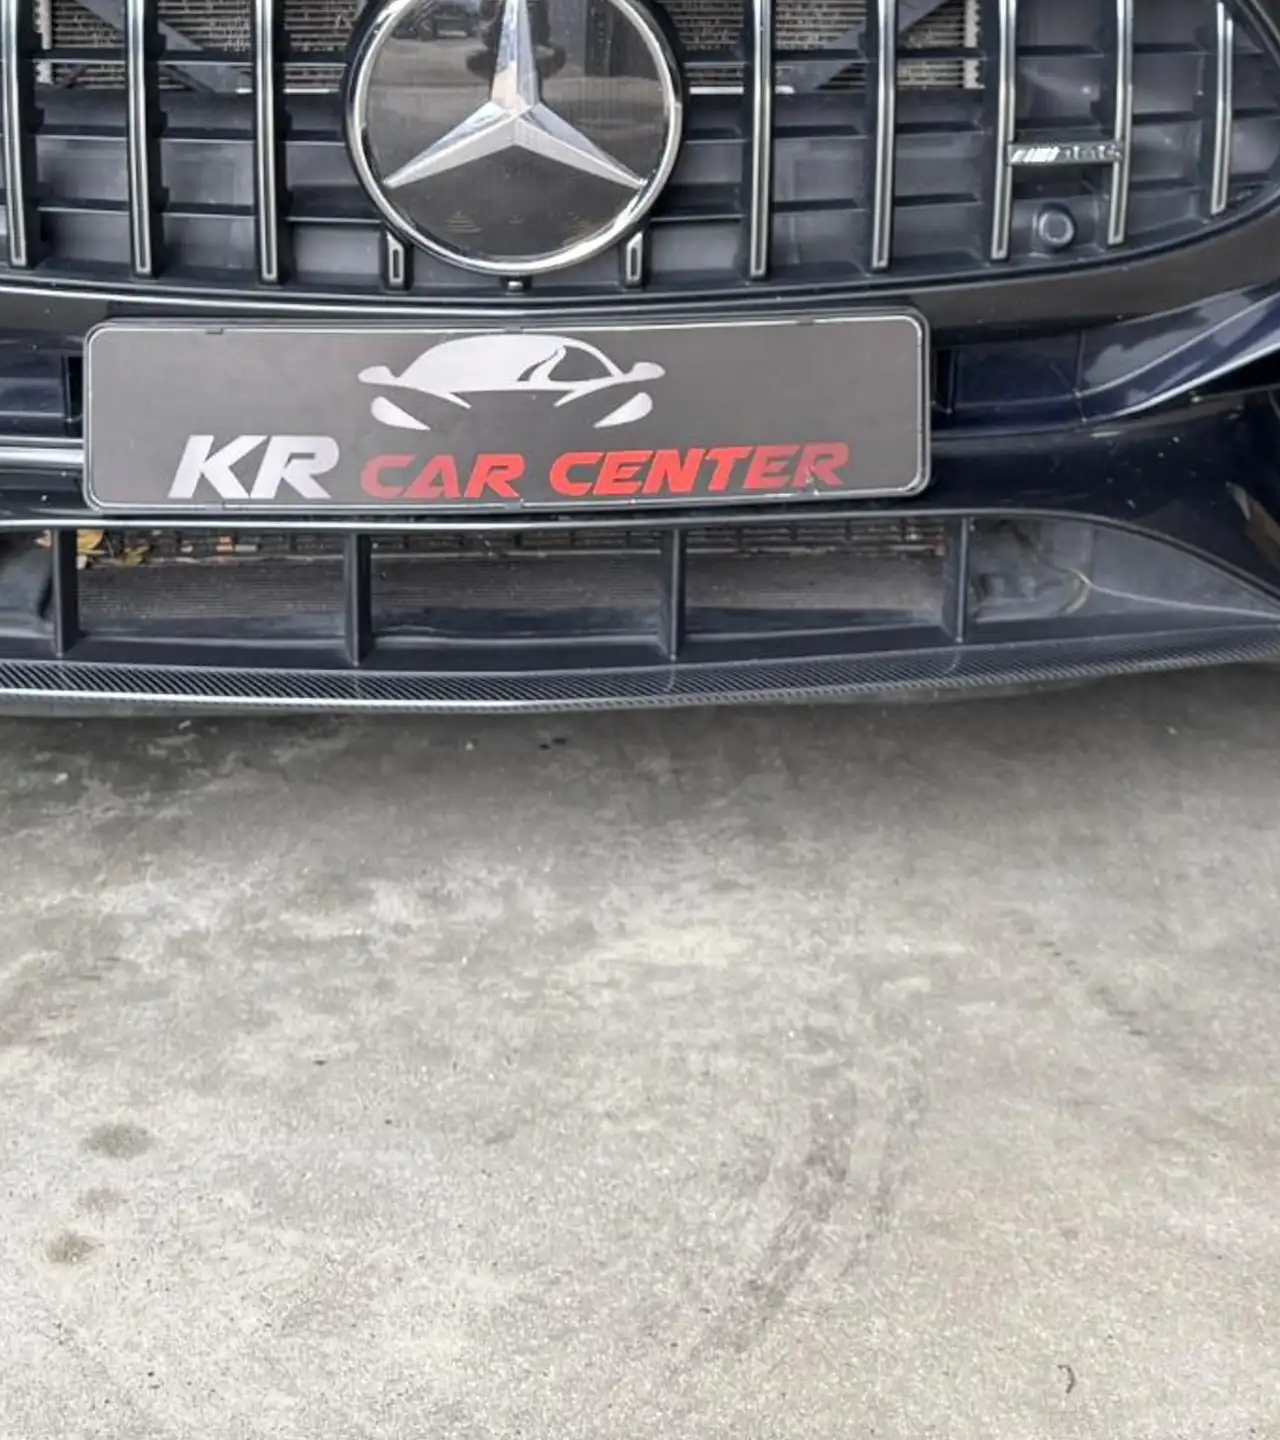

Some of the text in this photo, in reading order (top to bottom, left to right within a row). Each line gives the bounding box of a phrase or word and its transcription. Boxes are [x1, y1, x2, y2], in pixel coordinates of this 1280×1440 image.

[168, 434, 850, 499] KR CAR CENTER
